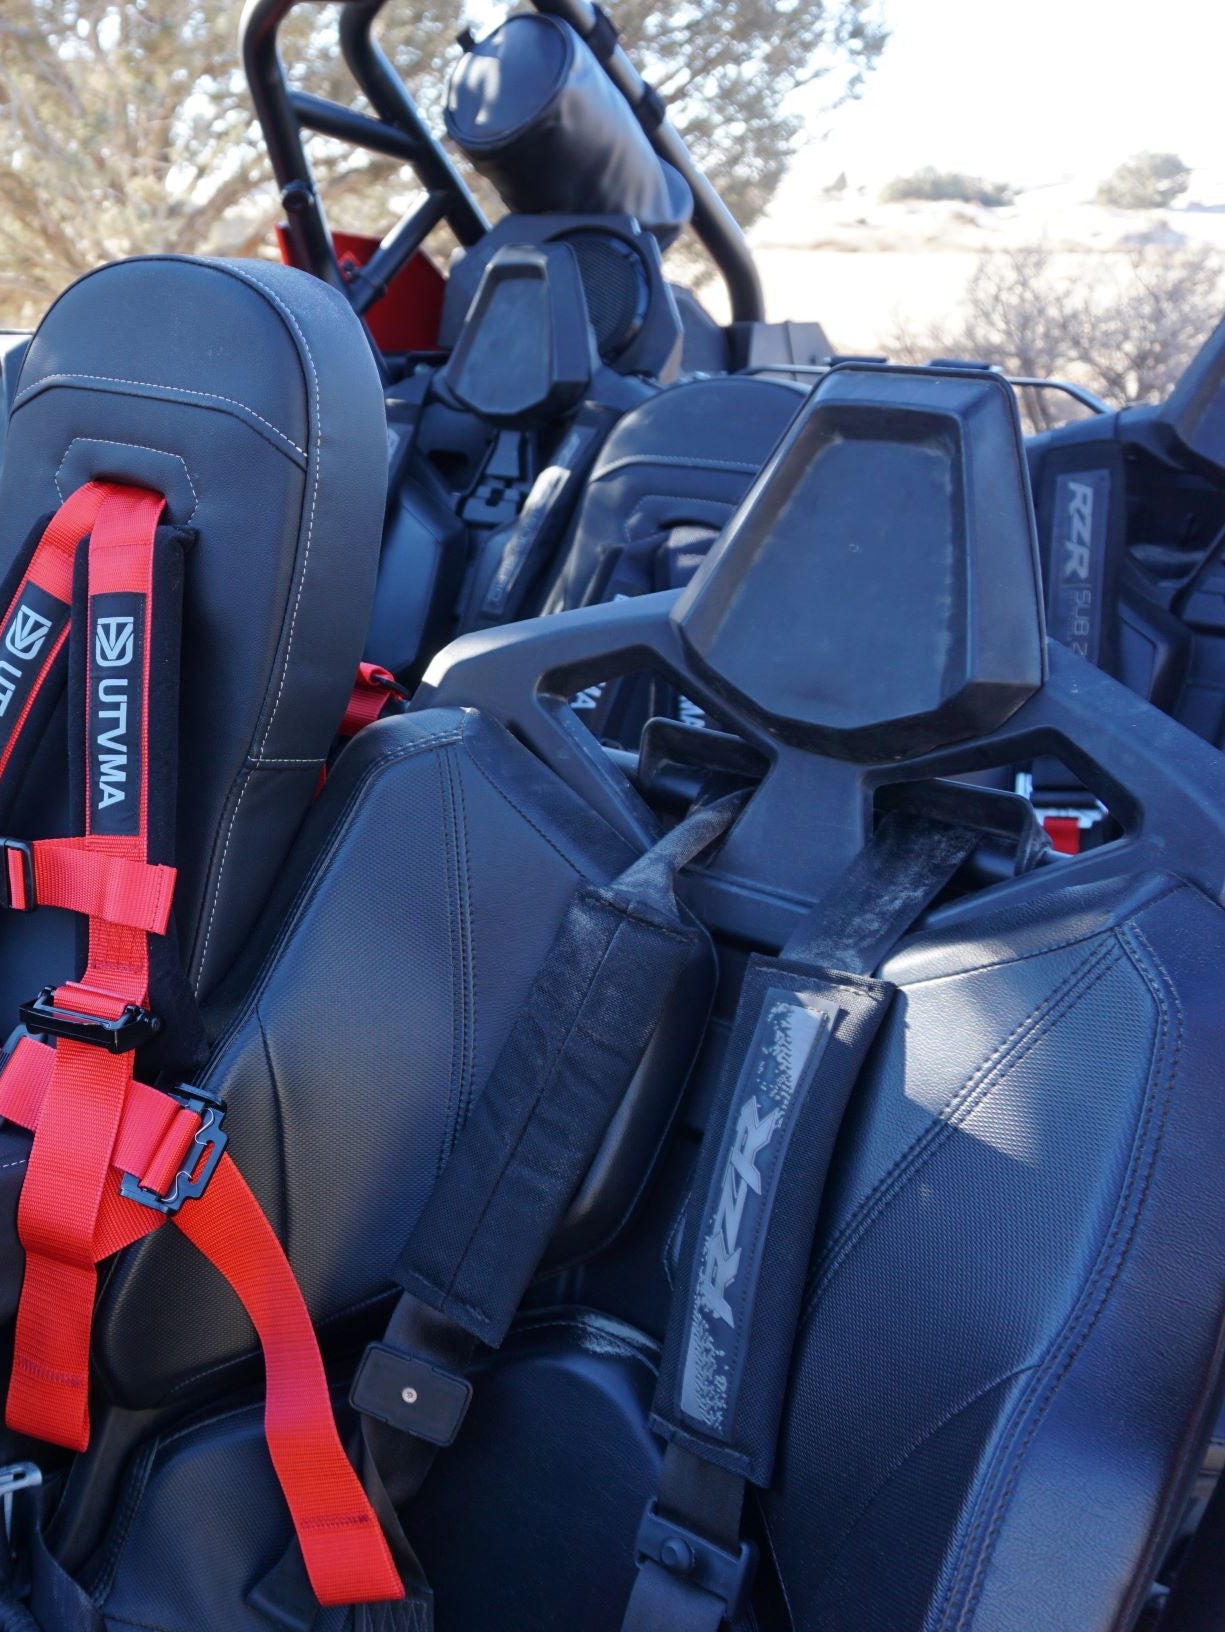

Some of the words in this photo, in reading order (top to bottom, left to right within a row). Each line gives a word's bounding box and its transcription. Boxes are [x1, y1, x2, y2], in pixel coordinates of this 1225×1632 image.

[1065, 481, 1093, 580] RZR
[97, 678, 128, 810] UTVMA
[701, 1096, 778, 1329] RZR
